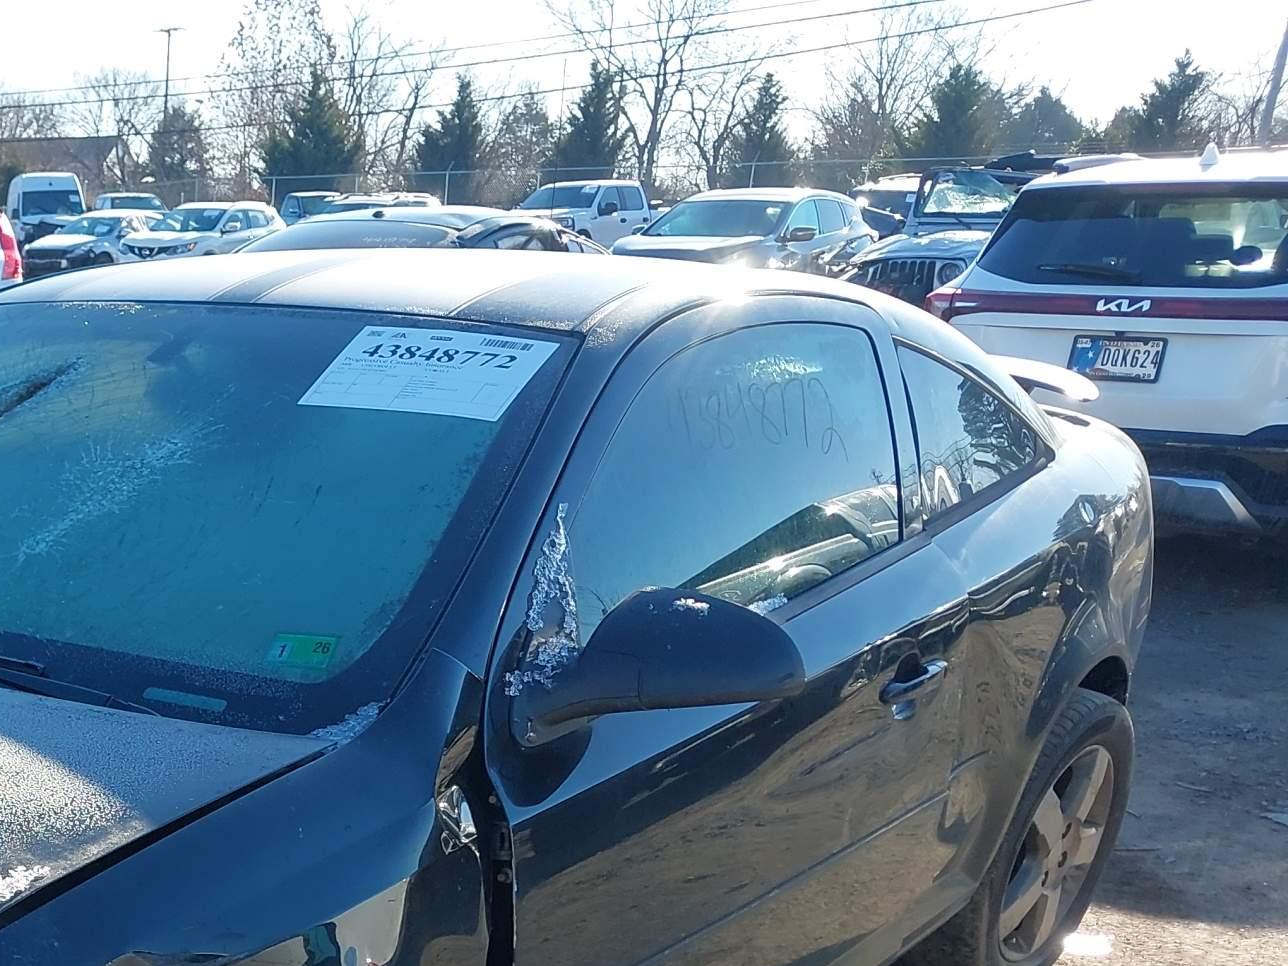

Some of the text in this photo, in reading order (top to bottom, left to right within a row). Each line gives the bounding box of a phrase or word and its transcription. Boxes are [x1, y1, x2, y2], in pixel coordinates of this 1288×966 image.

[1096, 299, 1151, 312] KIA
[362, 343, 518, 369] 43848772
[1101, 347, 1160, 370] DQK624
